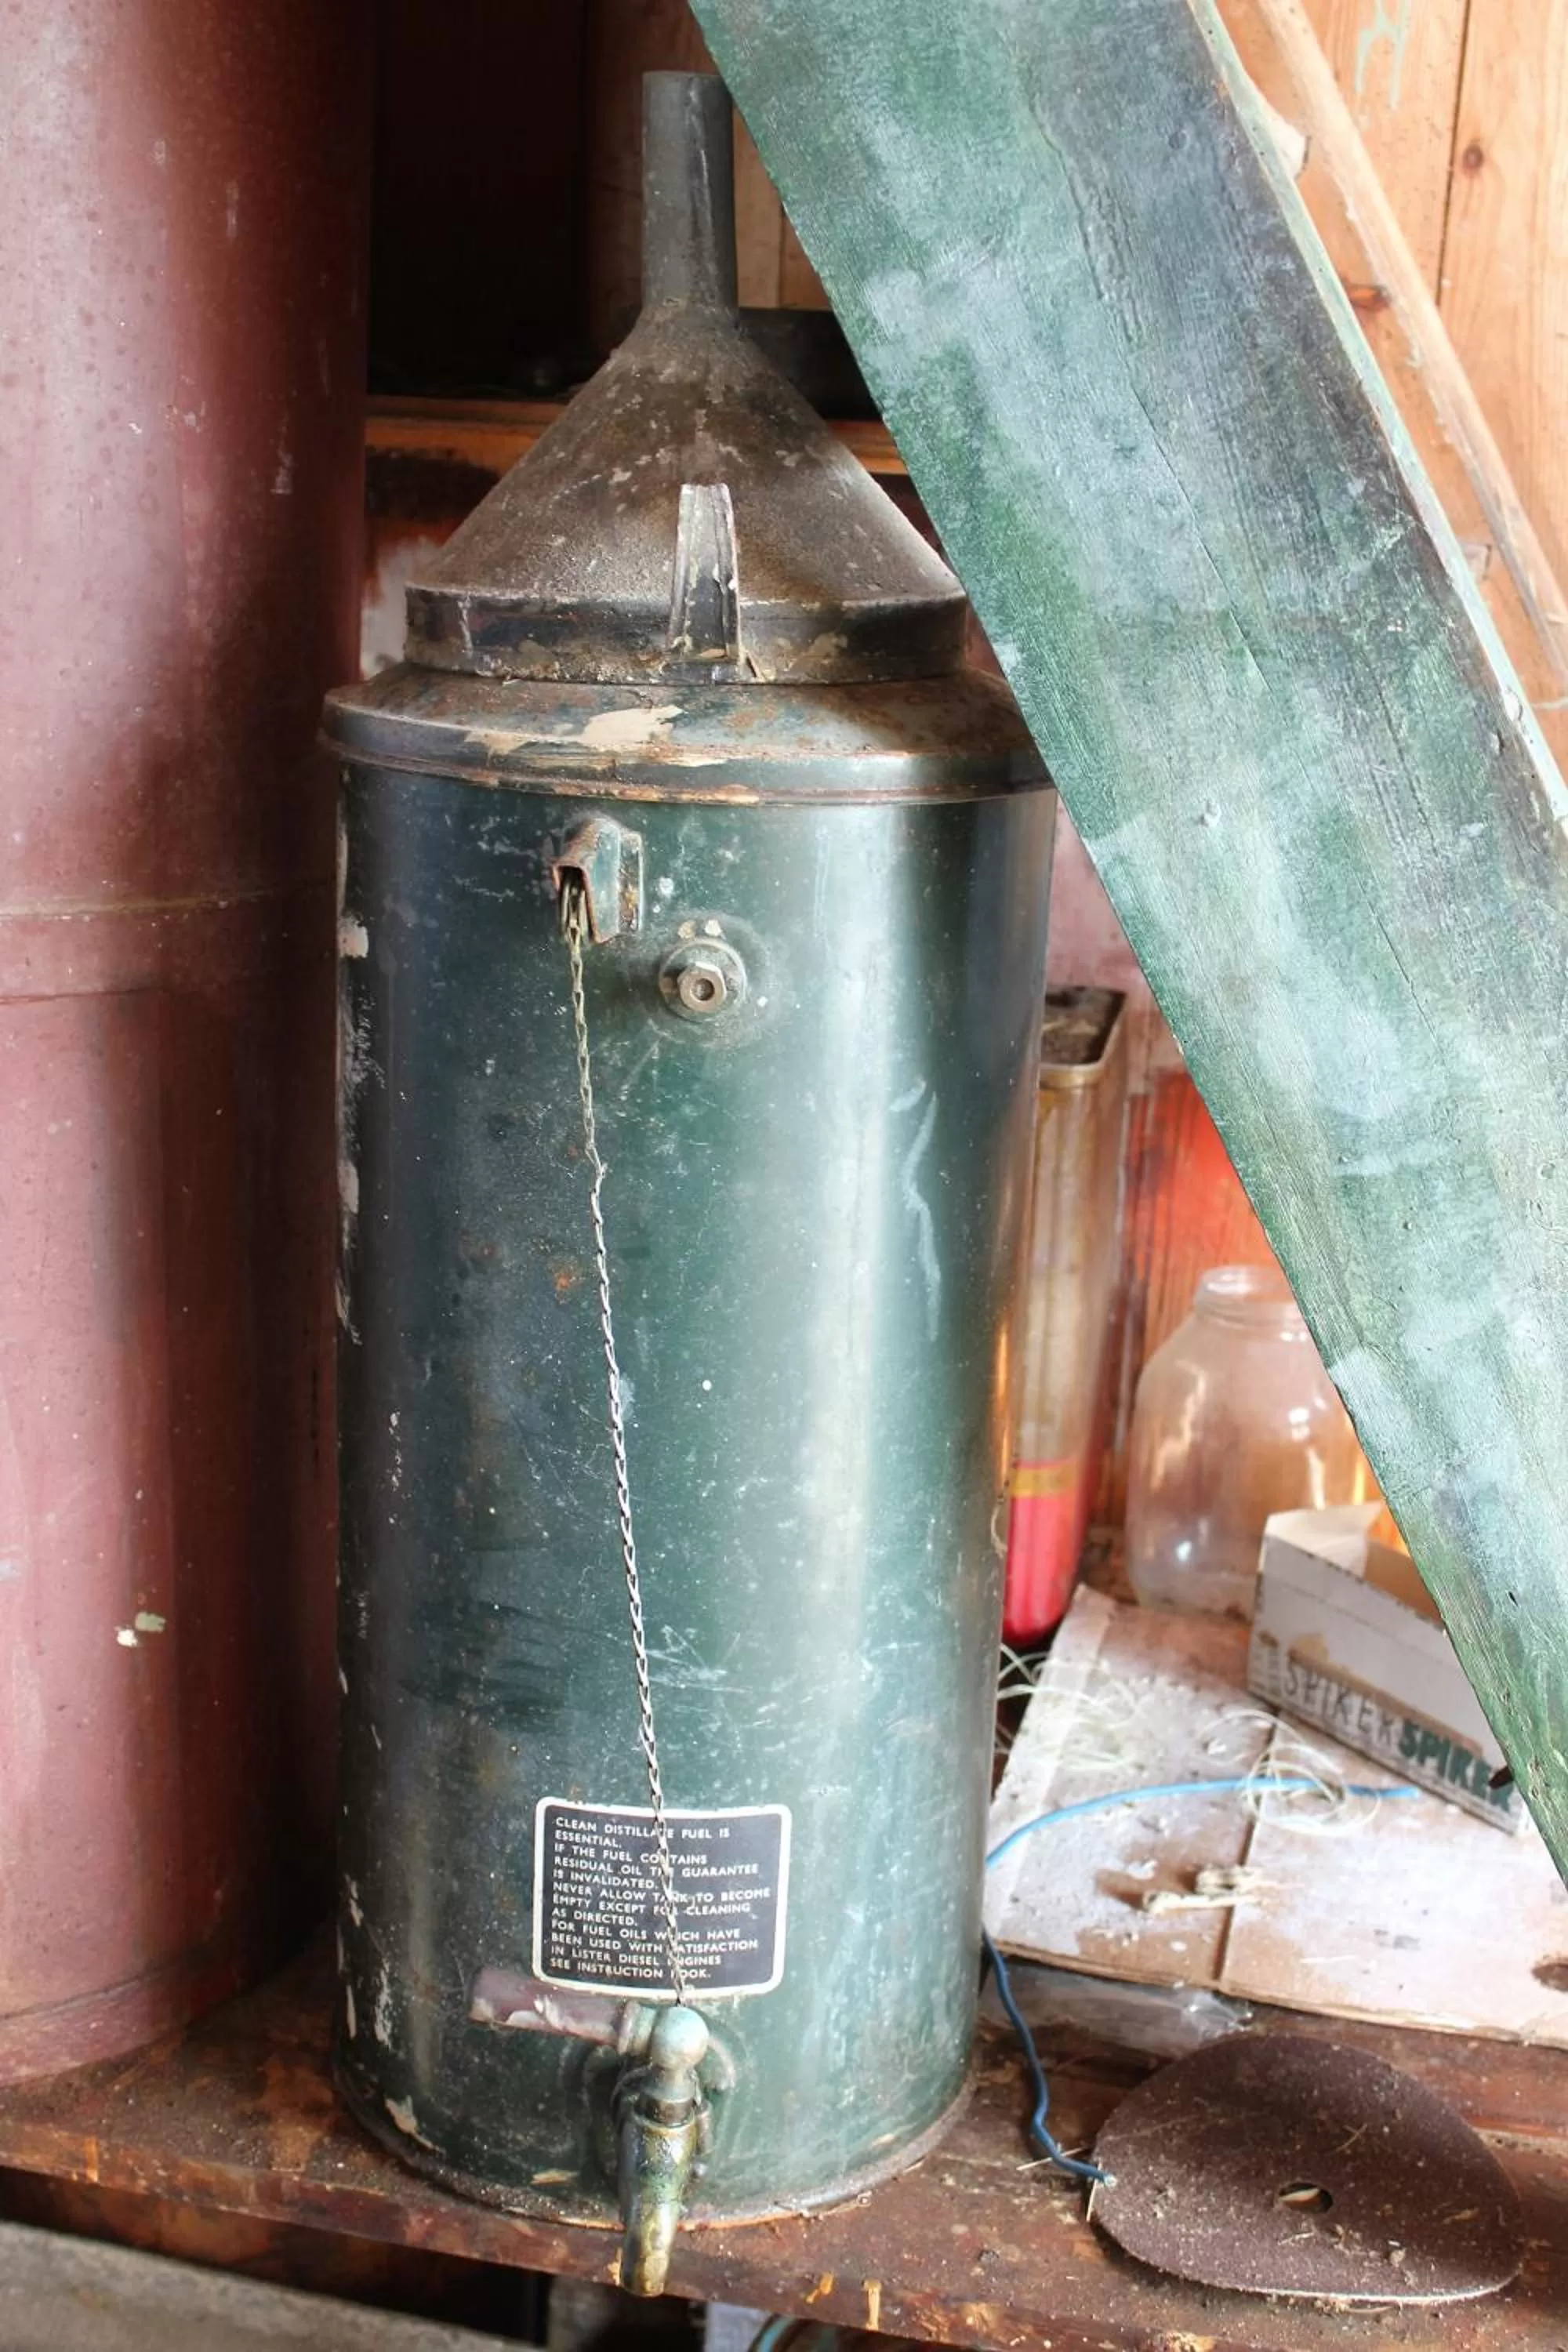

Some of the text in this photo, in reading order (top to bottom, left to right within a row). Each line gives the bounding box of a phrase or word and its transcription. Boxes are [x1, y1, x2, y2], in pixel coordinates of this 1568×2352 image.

[556, 1817, 730, 1838] CLEAN DISTILLAE FUEL IS
[554, 1830, 622, 1848] ESSENTIAL.
[554, 1842, 707, 1865] IF THE FUEL COTAINS
[554, 1856, 613, 1873] RESIDUAL
[621, 1864, 642, 1876] OIL
[682, 1863, 759, 1878] GUARANTEE
[554, 1869, 659, 1889] IS INVALIDATED.
[554, 1882, 593, 1896] NEVER
[600, 1889, 646, 1900] ALLOW
[696, 1892, 714, 1903] TO
[720, 1887, 771, 1901] BECOME
[553, 1893, 590, 1907] EMPTY
[599, 1900, 646, 1914] EXCEPT
[686, 1902, 750, 1915] CLEANING
[552, 1907, 638, 1926] AS DIRECTED.
[552, 1919, 741, 1941] FOR FUEL OILS WICH HAVE
[551, 1933, 759, 1954] BEEN USED WITH ATISFACTION
[552, 1945, 564, 1955] IN
[572, 1947, 611, 1962] LISTER
[619, 1953, 659, 1965] DIESEL
[550, 1958, 570, 1969] SEE
[577, 1962, 662, 1978] INSTRUCTION
